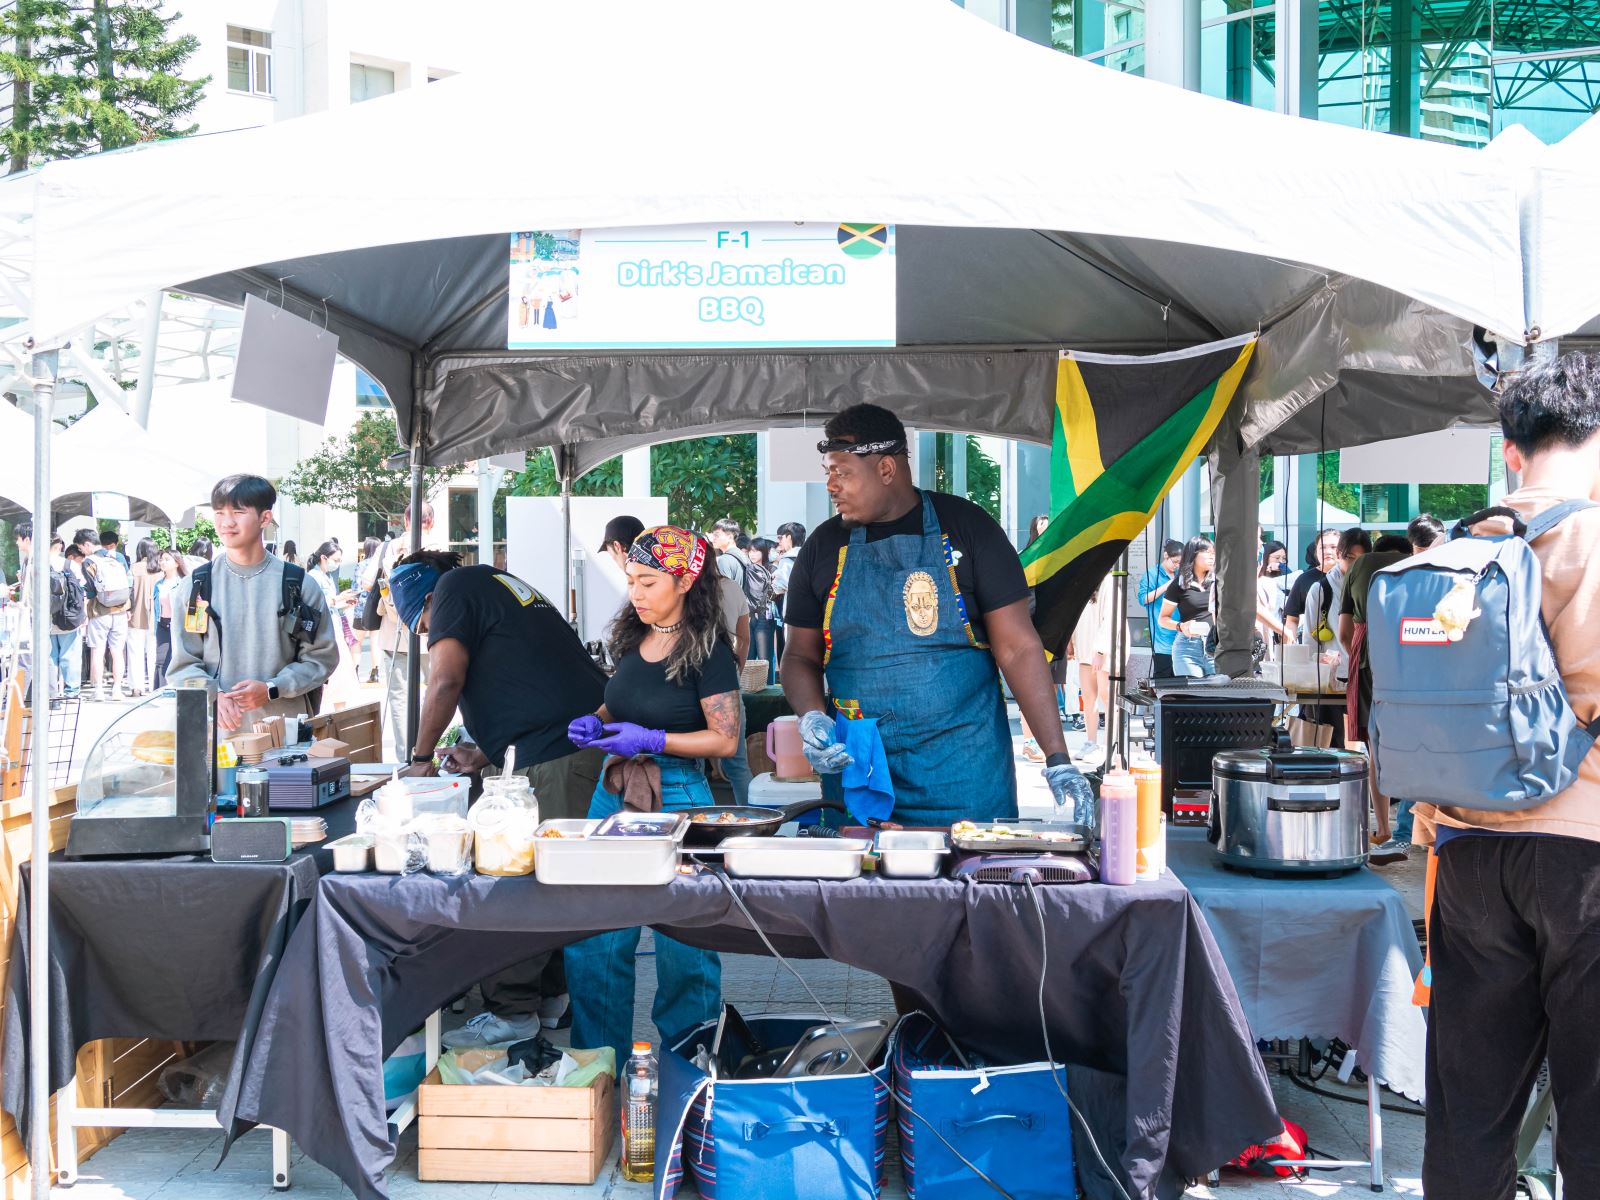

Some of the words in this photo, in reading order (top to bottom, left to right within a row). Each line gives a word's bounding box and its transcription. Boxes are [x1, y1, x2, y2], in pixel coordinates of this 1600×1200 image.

[717, 230, 749, 249] F-1
[618, 259, 703, 287] Dirk's
[706, 257, 846, 287] Jamaican
[698, 296, 765, 326] BBQ
[689, 541, 706, 577] RLEY
